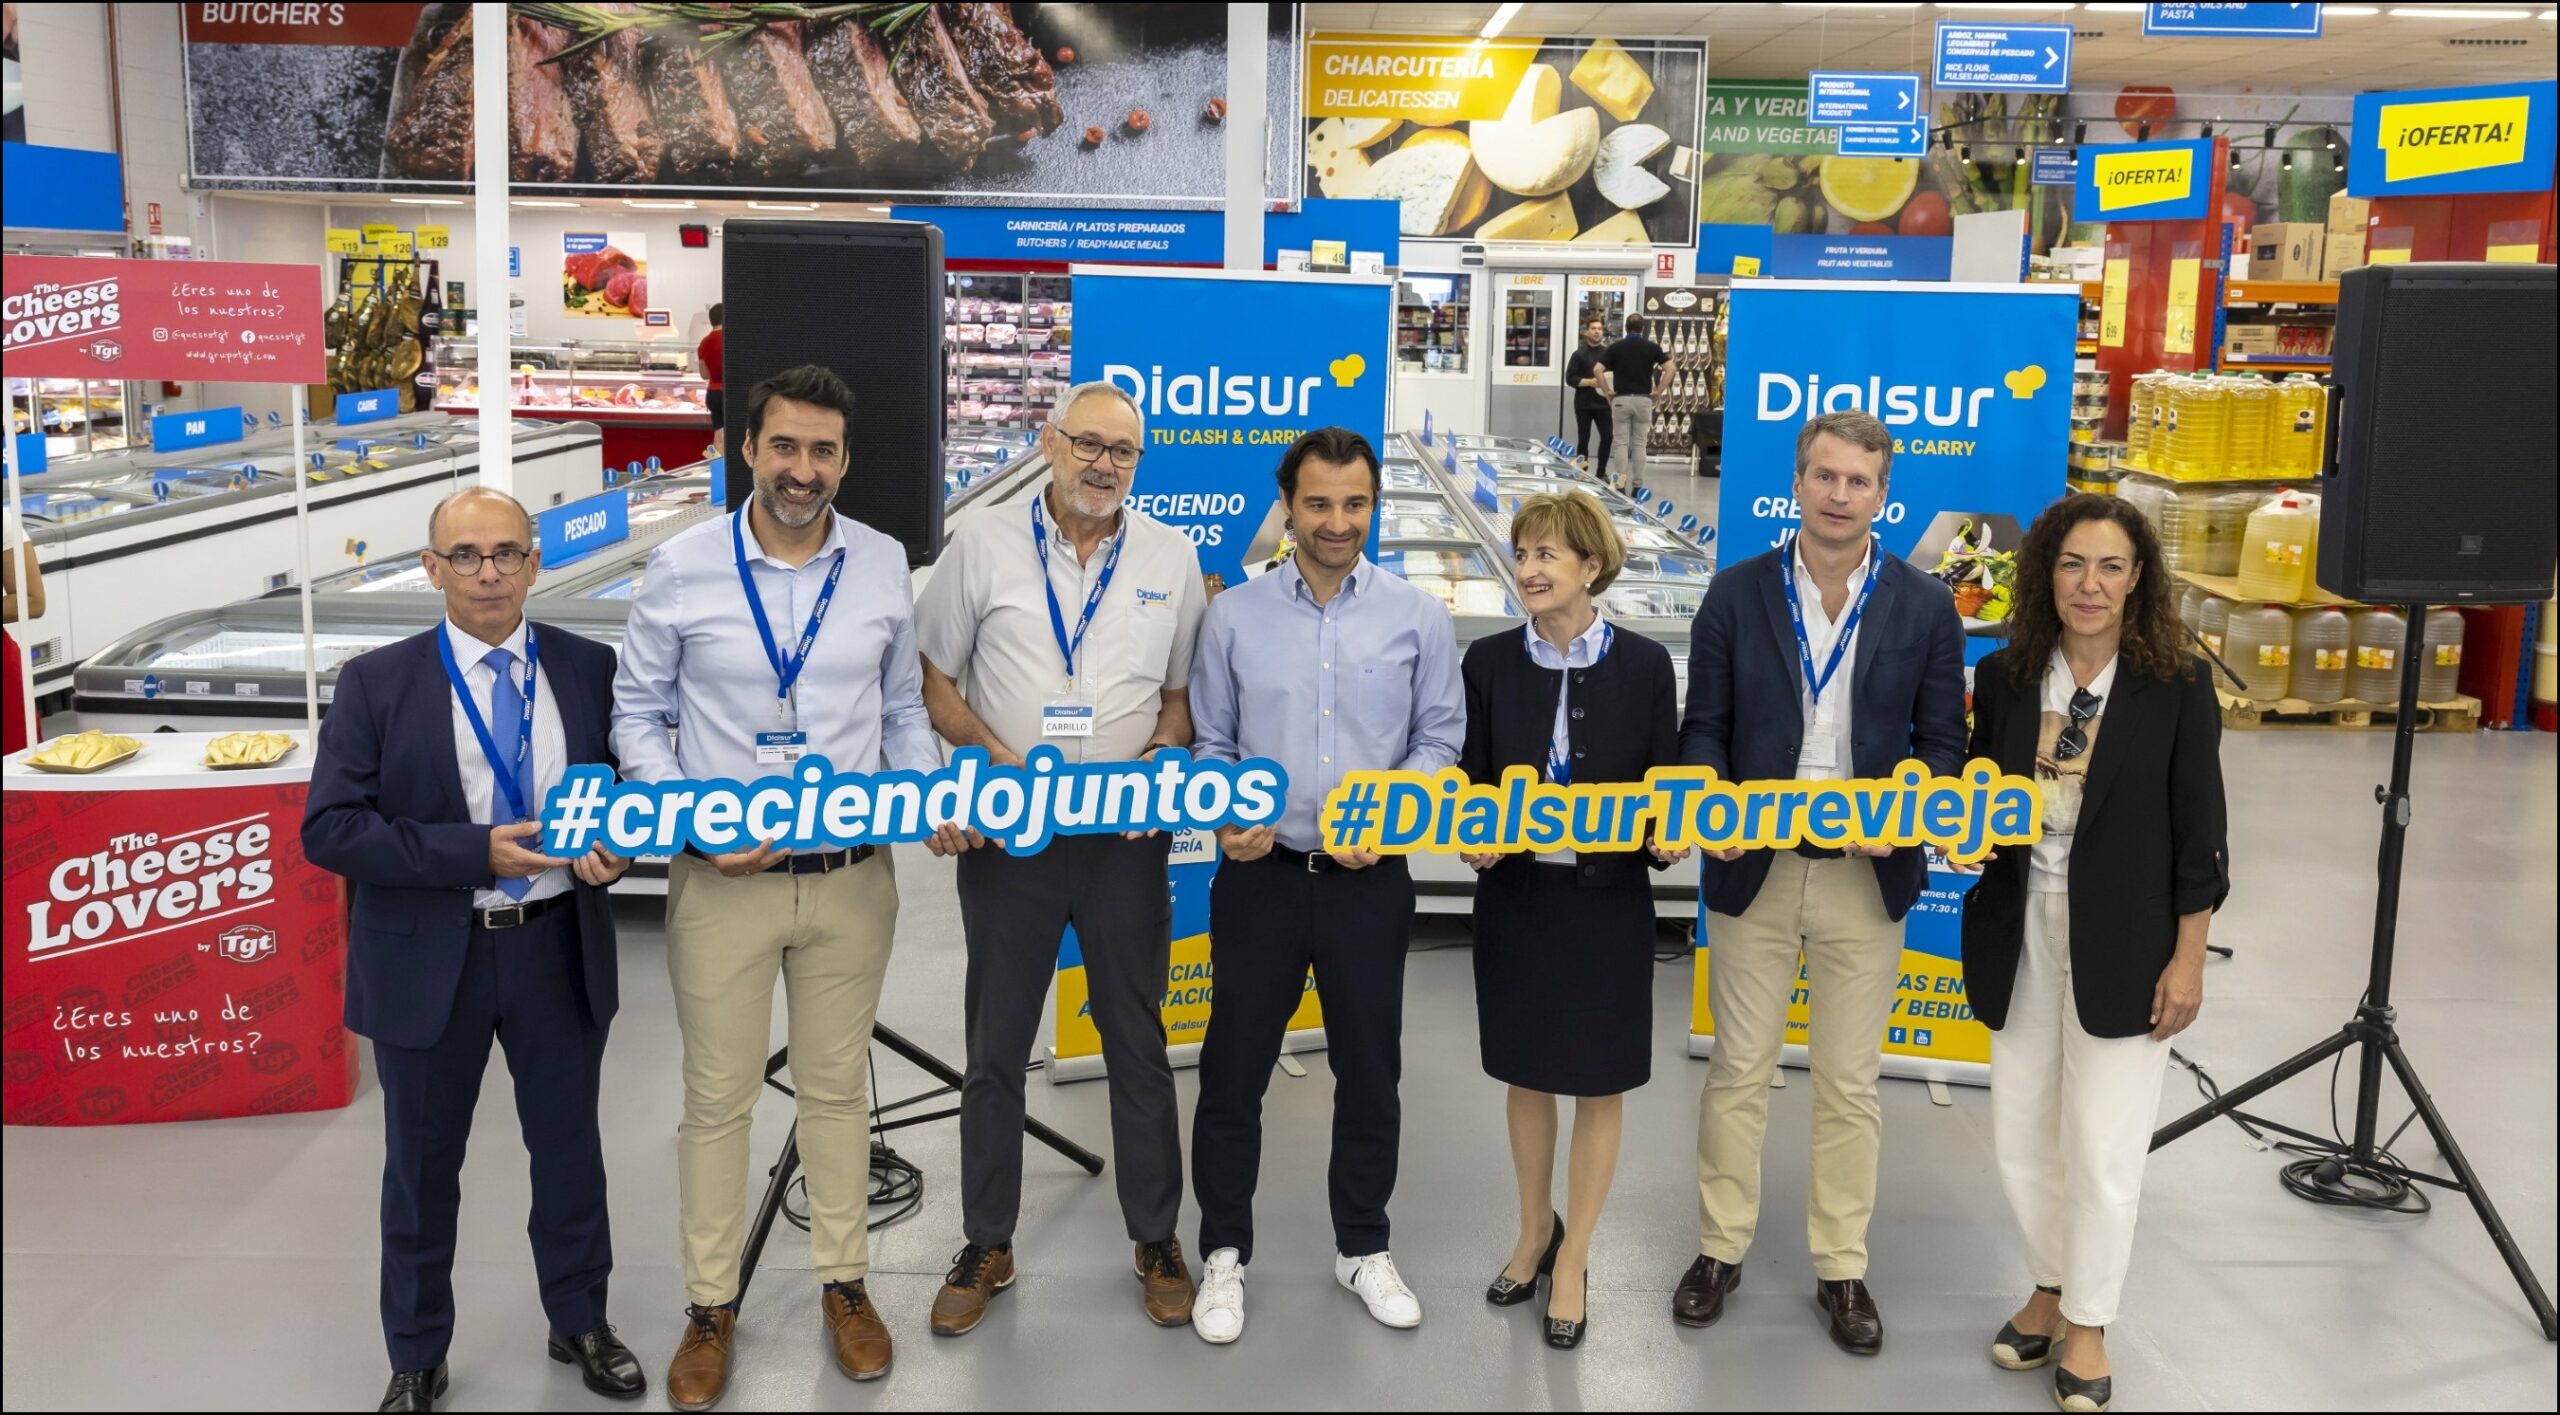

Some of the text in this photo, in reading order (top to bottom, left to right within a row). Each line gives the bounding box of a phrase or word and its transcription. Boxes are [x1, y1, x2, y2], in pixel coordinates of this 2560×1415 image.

[2160, 10, 2195, 20] PASTA
[1945, 48, 2036, 57] CONSERVAS DE PESCADO
[1324, 52, 1495, 79] CHARCUTERÍA
[1818, 81, 1855, 89] PRODUCTO
[1944, 72, 2038, 82] PULSES AND CANNED FISH
[1323, 88, 1461, 109] DELICATESSEN
[1818, 88, 1871, 97] INTERNACIONAL
[1735, 97, 1749, 116] Y
[1754, 97, 1807, 117] VERD
[1817, 103, 1869, 111] INTERNATIONAL
[1709, 126, 1837, 144] AND VEGETAB
[2397, 122, 2514, 148] ¡OFERTA!
[2107, 167, 2183, 187] ¡OFERTA!
[1006, 219, 1069, 232] CARNICERÍA
[1075, 222, 1116, 233] PLATOS
[1117, 222, 1186, 234] PREPARADOS
[1076, 238, 1136, 249] READY-MADE
[1137, 240, 1170, 250] MEALS
[1824, 247, 1888, 255] FRUTA Y VERDURA
[1817, 260, 1893, 268] FRUIT AND VEGETABLES
[33, 282, 60, 296] The
[171, 281, 281, 299] ¿Eres uno de
[1513, 275, 1628, 287] LIBRE SERVICIO
[3, 282, 119, 321] Cheese
[178, 301, 286, 318] los nuestros?
[92, 344, 120, 360] Tgt
[1512, 373, 1539, 384] SELF
[1103, 364, 1322, 416] Dialsur
[357, 399, 379, 414] CARNE
[1757, 372, 1995, 428] Dialsur
[185, 421, 207, 437] PAN
[1151, 429, 1176, 445] TU
[1181, 429, 1228, 445] CASH
[1231, 429, 1244, 445] &
[1892, 439, 1977, 457] & CARRY
[1123, 493, 1246, 517] RECIENDO
[564, 509, 607, 543] PESCADO
[1136, 588, 1169, 601] Dialsur
[1046, 722, 1088, 732] CARRILLO
[549, 757, 1277, 849] #creciendojuntos
[1329, 772, 2032, 855] #DialsurTorrevieja
[110, 832, 159, 855] The
[49, 823, 271, 901] Cheese
[1919, 889, 1960, 900] ernes de
[26, 858, 275, 952] Lovers
[1916, 902, 1929, 912] de
[1930, 903, 1951, 913] 7:30
[197, 934, 273, 959] by Tgt
[1933, 976, 1965, 995] EN
[53, 1005, 133, 1031] ¿Eres
[154, 1008, 199, 1025] uno
[221, 993, 254, 1021] de
[1907, 999, 1974, 1021] BEBID
[64, 1031, 263, 1062] los nuestros?
